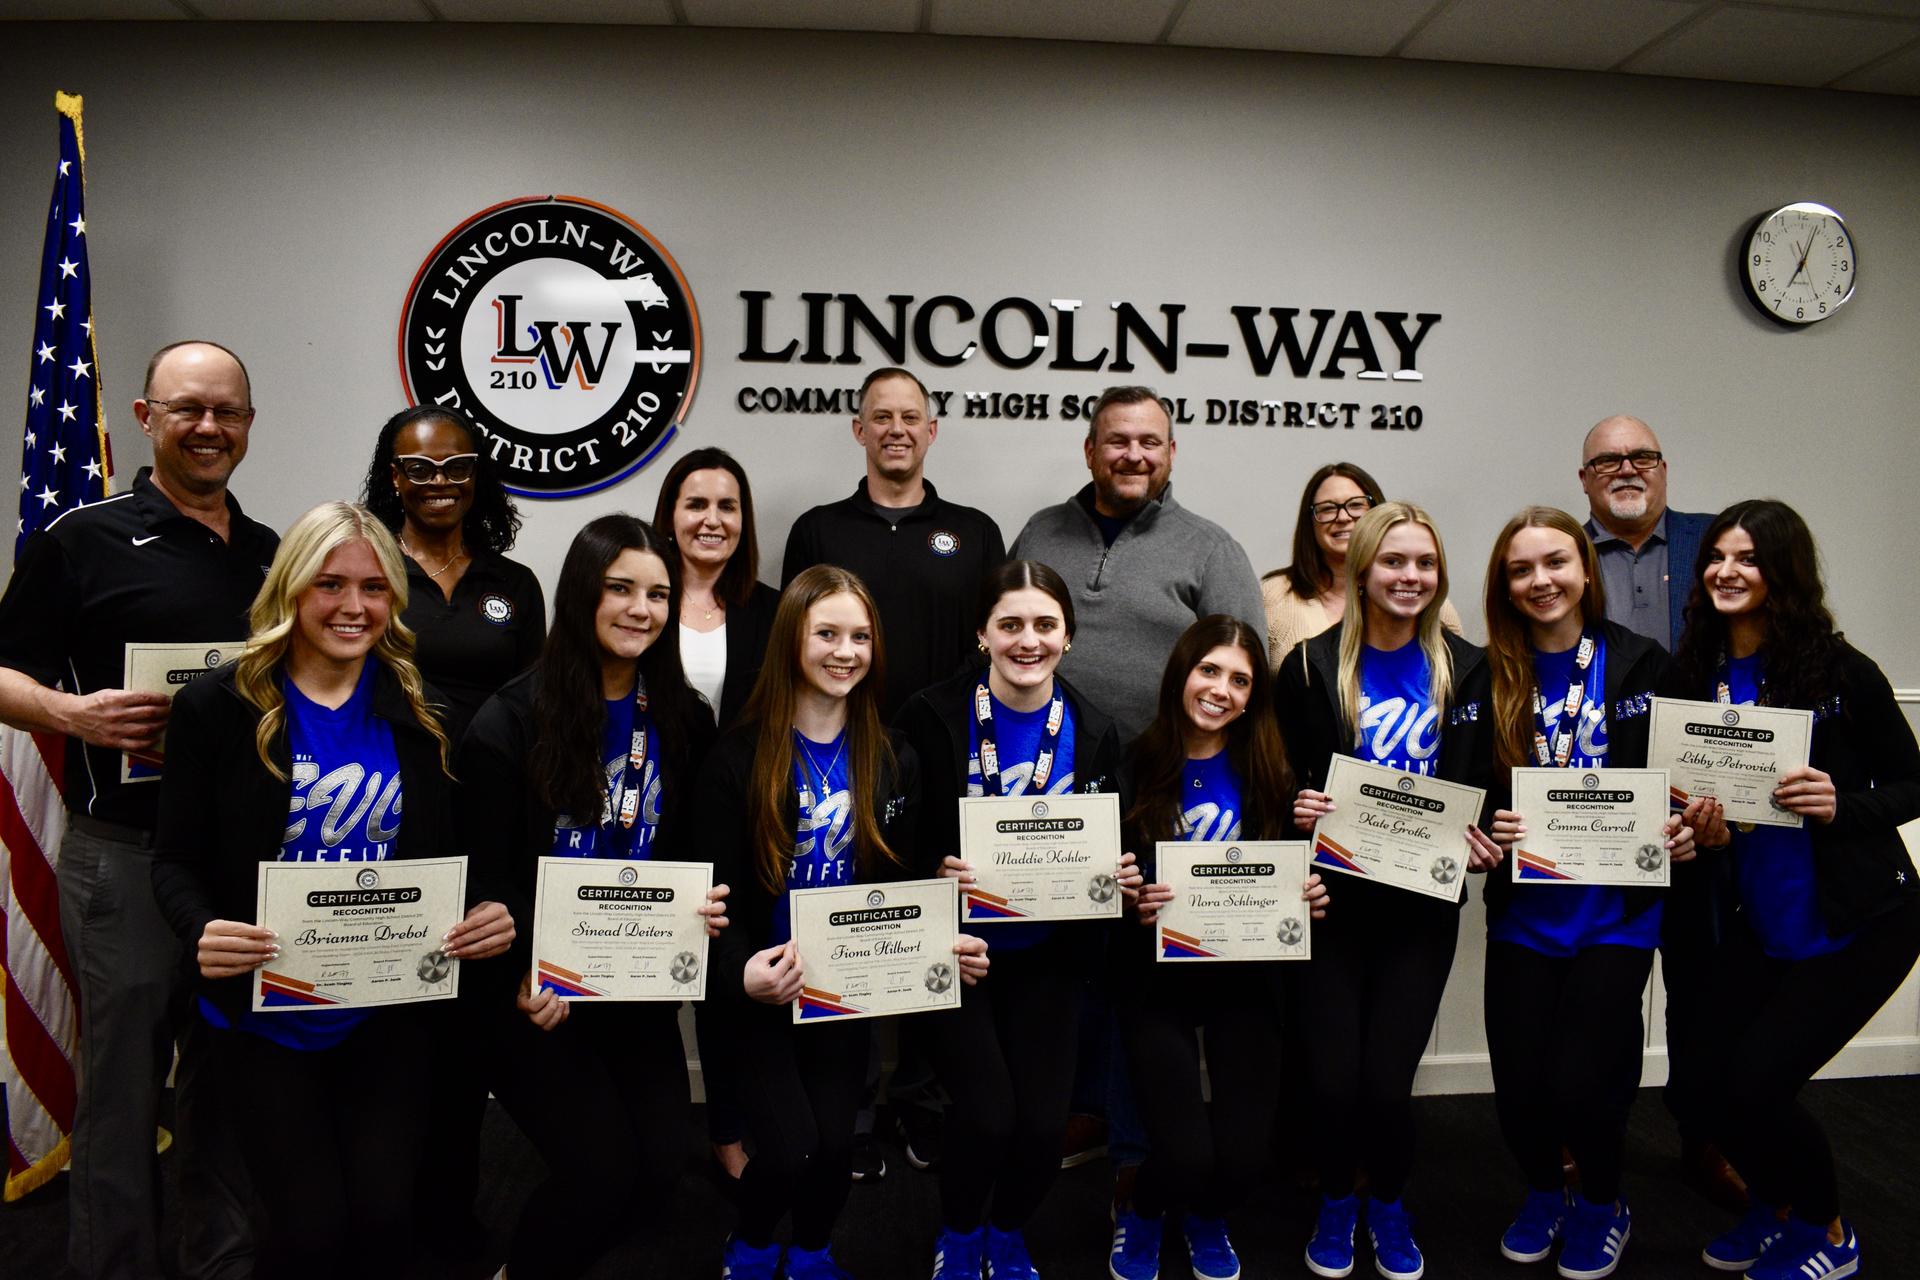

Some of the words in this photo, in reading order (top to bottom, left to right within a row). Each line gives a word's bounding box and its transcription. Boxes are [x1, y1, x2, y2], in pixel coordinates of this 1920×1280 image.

[1757, 231, 1771, 242] 10
[1836, 236, 1844, 247] 2
[1753, 255, 1761, 266] 9
[1841, 260, 1848, 271] 3
[1759, 280, 1766, 291] 8
[1834, 285, 1841, 295] 4
[1774, 300, 1781, 311] 7
[1819, 302, 1826, 313] 5
[1796, 307, 1804, 319] 6
[491, 295, 622, 387] LW
[738, 290, 1441, 380] LINCOLN-WAY
[490, 371, 537, 389] 210
[738, 387, 953, 417] COMMUY
[964, 391, 1049, 418] HIGH
[1205, 399, 1360, 428] DISTRICT
[1371, 404, 1423, 430] 210
[434, 387, 600, 472] DTRICT
[611, 391, 660, 447] 210
[1686, 725, 1753, 739] CERTIFICATE
[1757, 732, 1772, 740] OF
[1704, 739, 1753, 749] RECOGNITION
[1676, 751, 1714, 769] Libby
[1716, 755, 1776, 773] Petrovich
[1362, 786, 1425, 807] CERTIFICATE
[1428, 801, 1443, 811] OF
[1549, 792, 1614, 800] CERTIFICATE
[1617, 793, 1632, 801] OF
[1376, 801, 1423, 816] RECOGNITION
[998, 821, 1064, 831] CERTIFICATE
[1067, 820, 1082, 829] OF
[1358, 812, 1389, 830] Kate
[1391, 820, 1431, 840] Grotke
[1547, 818, 1587, 831] Emma
[1591, 819, 1636, 833] Carroll
[992, 851, 1044, 865] Maddie
[1046, 850, 1091, 864] Kohler
[1193, 866, 1256, 875] CERTIFICATE
[1259, 866, 1273, 874] OF
[309, 891, 396, 905] CERTIFICATE
[401, 890, 418, 900] OF
[580, 889, 652, 900] CERTIFICATE
[656, 891, 671, 900] OF
[1188, 894, 1220, 907] Nora
[1223, 894, 1278, 908] Schlinger
[333, 907, 396, 916] RECOGNITION
[831, 910, 900, 924] CERTIFICATE
[904, 909, 919, 917] OF
[571, 921, 622, 937] Sinead
[625, 921, 673, 938] Deiters
[851, 923, 901, 933] RECOGNITION
[294, 928, 368, 946] Brianna
[374, 925, 429, 941] Drebot
[831, 944, 871, 960] Fiona
[874, 941, 921, 955] Hilbert
